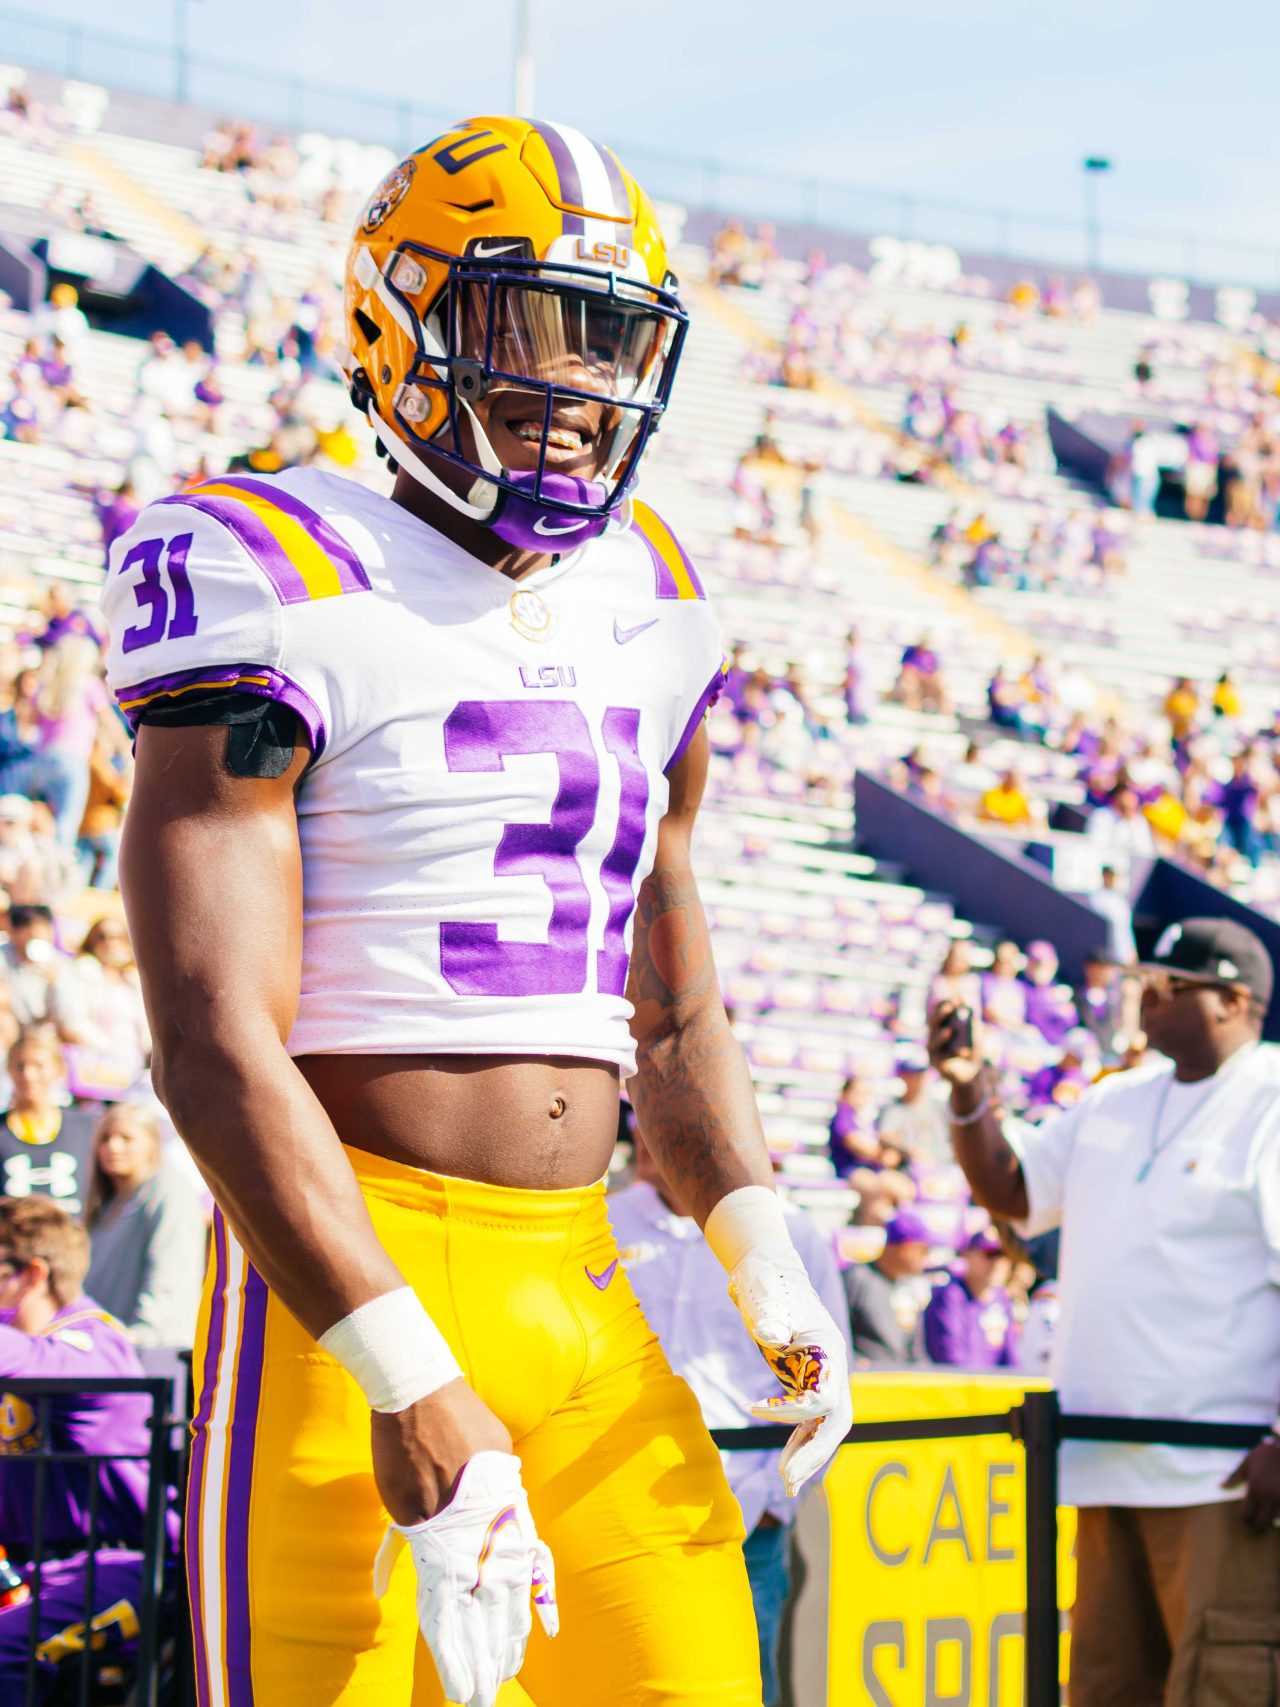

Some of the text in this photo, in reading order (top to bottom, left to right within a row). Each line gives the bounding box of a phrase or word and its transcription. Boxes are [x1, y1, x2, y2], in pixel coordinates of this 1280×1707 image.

[576, 238, 630, 269] LSU
[119, 533, 198, 654] 31
[518, 666, 577, 688] LSU
[440, 701, 649, 998] 31
